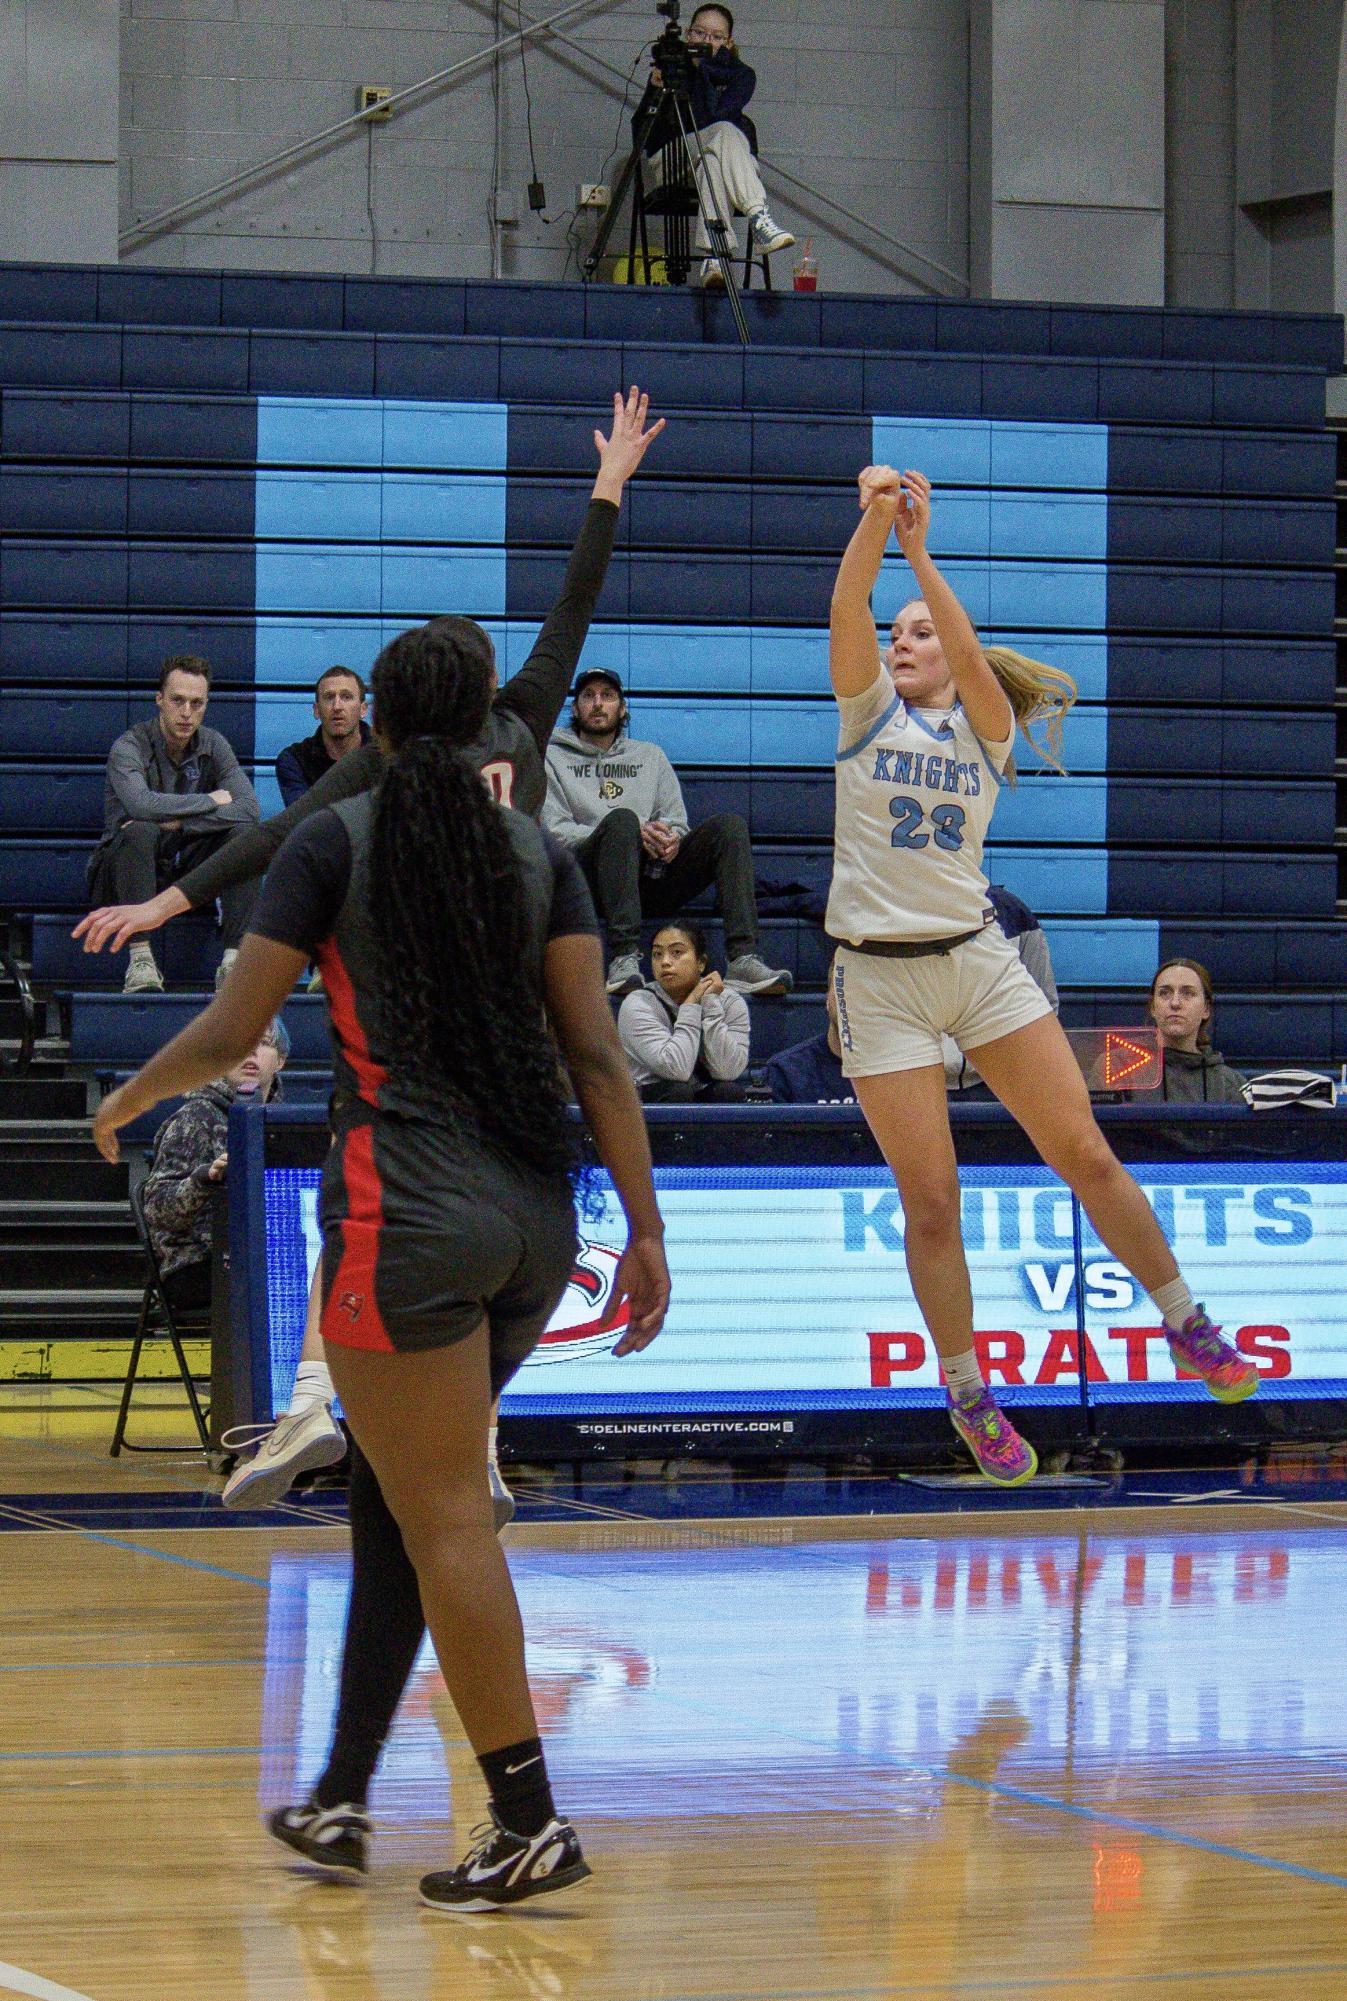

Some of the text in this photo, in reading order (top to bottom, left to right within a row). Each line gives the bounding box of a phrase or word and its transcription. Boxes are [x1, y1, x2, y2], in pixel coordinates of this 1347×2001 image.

[873, 748, 981, 796] KNIGHTS
[889, 796, 966, 851] 23
[835, 965, 853, 1052] PROSPECT
[1024, 1261, 1134, 1312] VS
[866, 1325, 1292, 1388] PRATS
[577, 1421, 781, 1435] SIDELINEINTERACTIVE.COM
